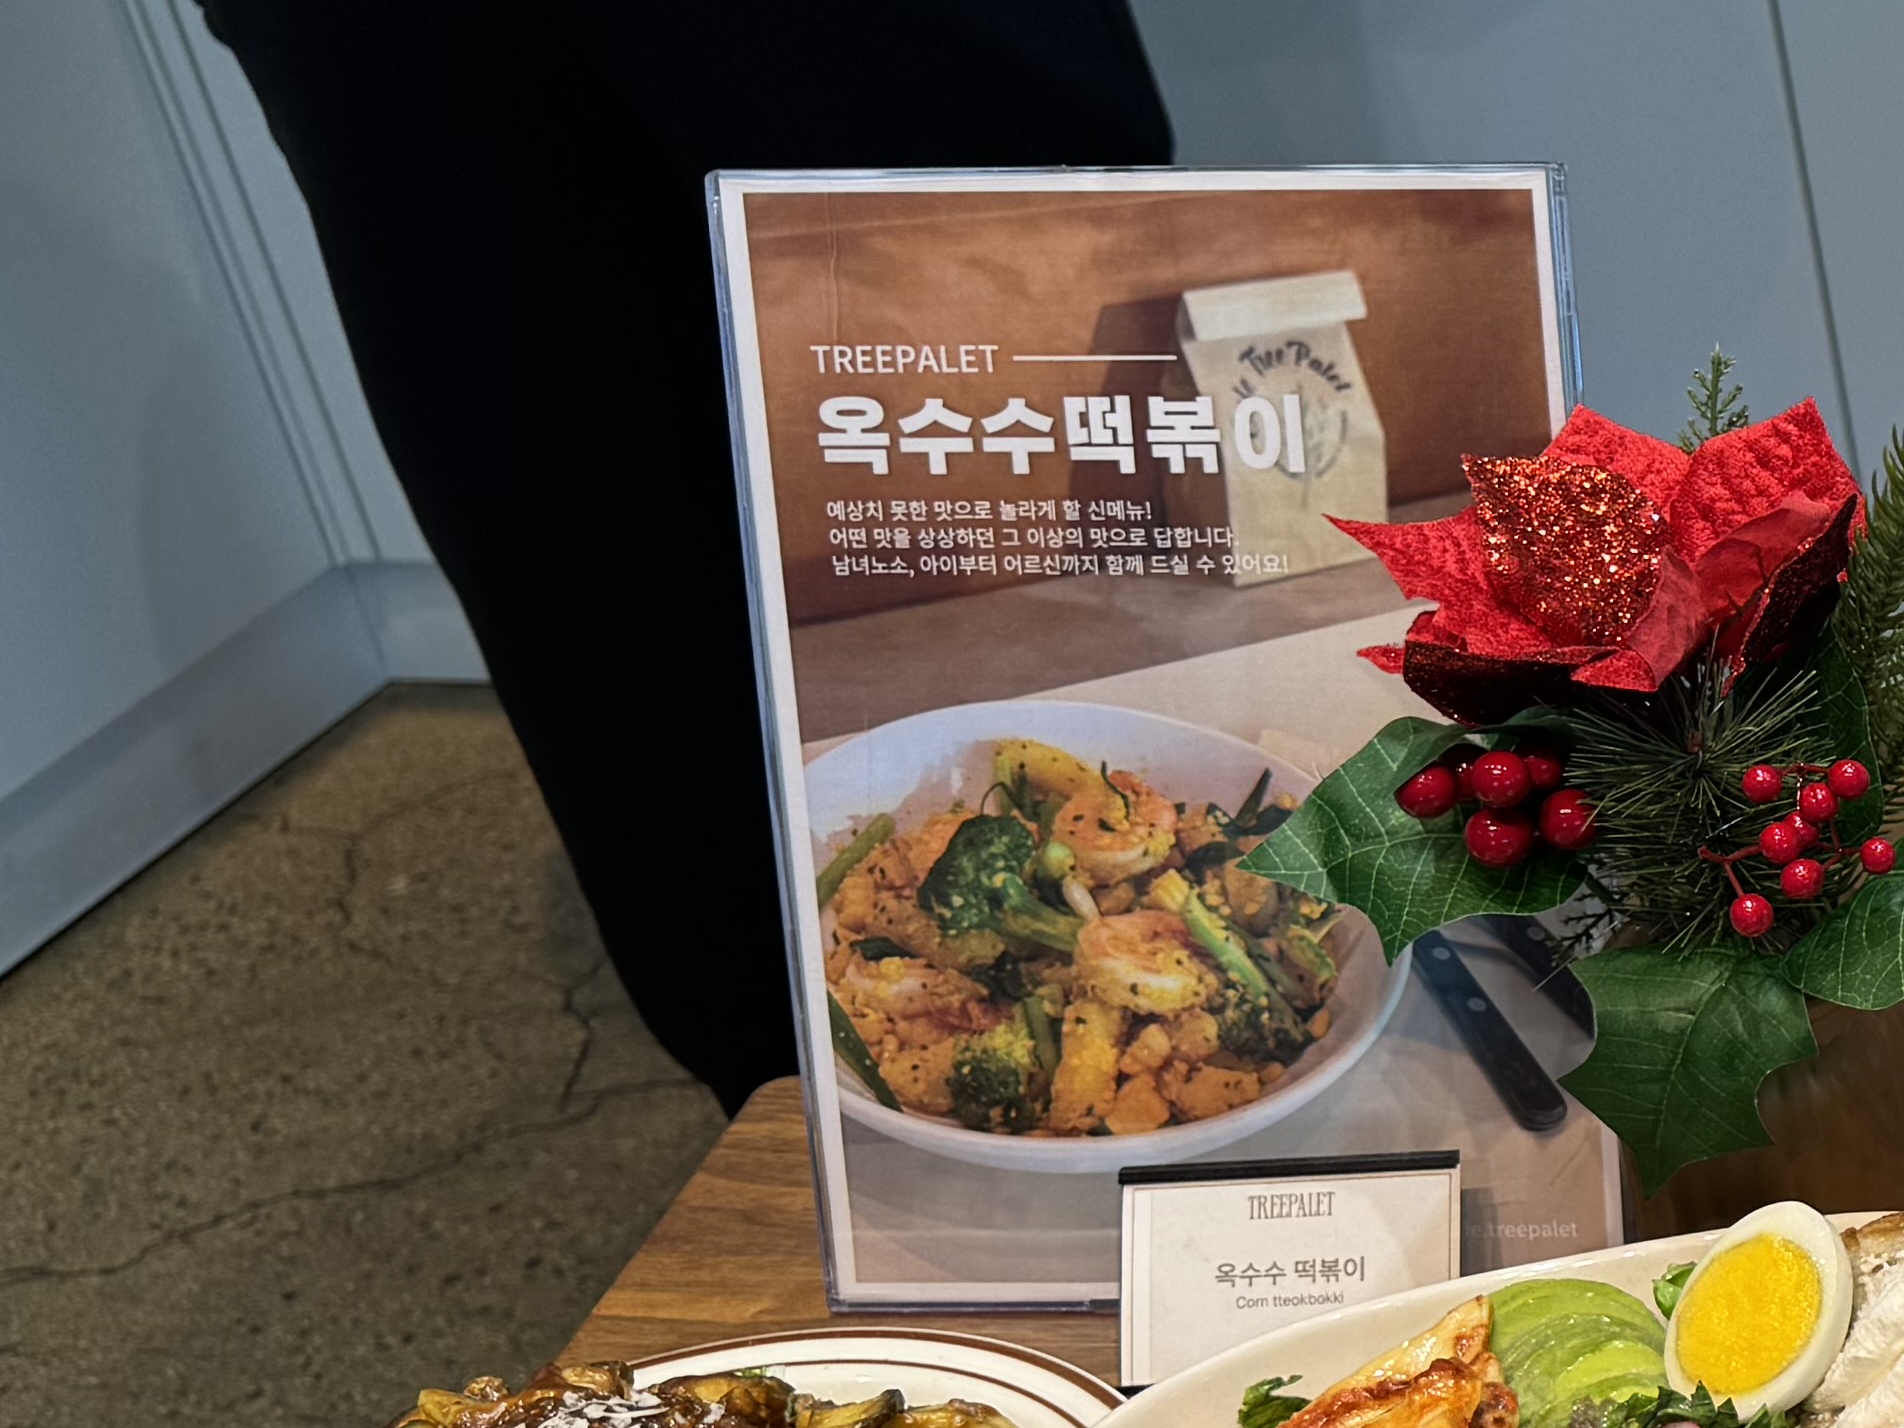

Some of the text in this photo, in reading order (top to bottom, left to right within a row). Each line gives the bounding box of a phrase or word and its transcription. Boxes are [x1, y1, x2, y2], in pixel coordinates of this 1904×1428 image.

[810, 345, 998, 373] TREEPALET
[818, 395, 1305, 475] 옥수수떡볶이
[827, 500, 1152, 522] 예상치 못한 맛으로 놀라게 할 신메뉴!
[830, 528, 1240, 548] 어떤 맛을 상상하던 그 이상의 맛으로 답합니다.
[833, 555, 1289, 577] 남녀노소, 아이부터 어르신까지 함께 드실 수 있어요!
[1248, 1191, 1335, 1220] TREEPALET
[1215, 1256, 1365, 1287] 옥수수 떡볶이
[1236, 1291, 1344, 1309] Corn tteokbokki
